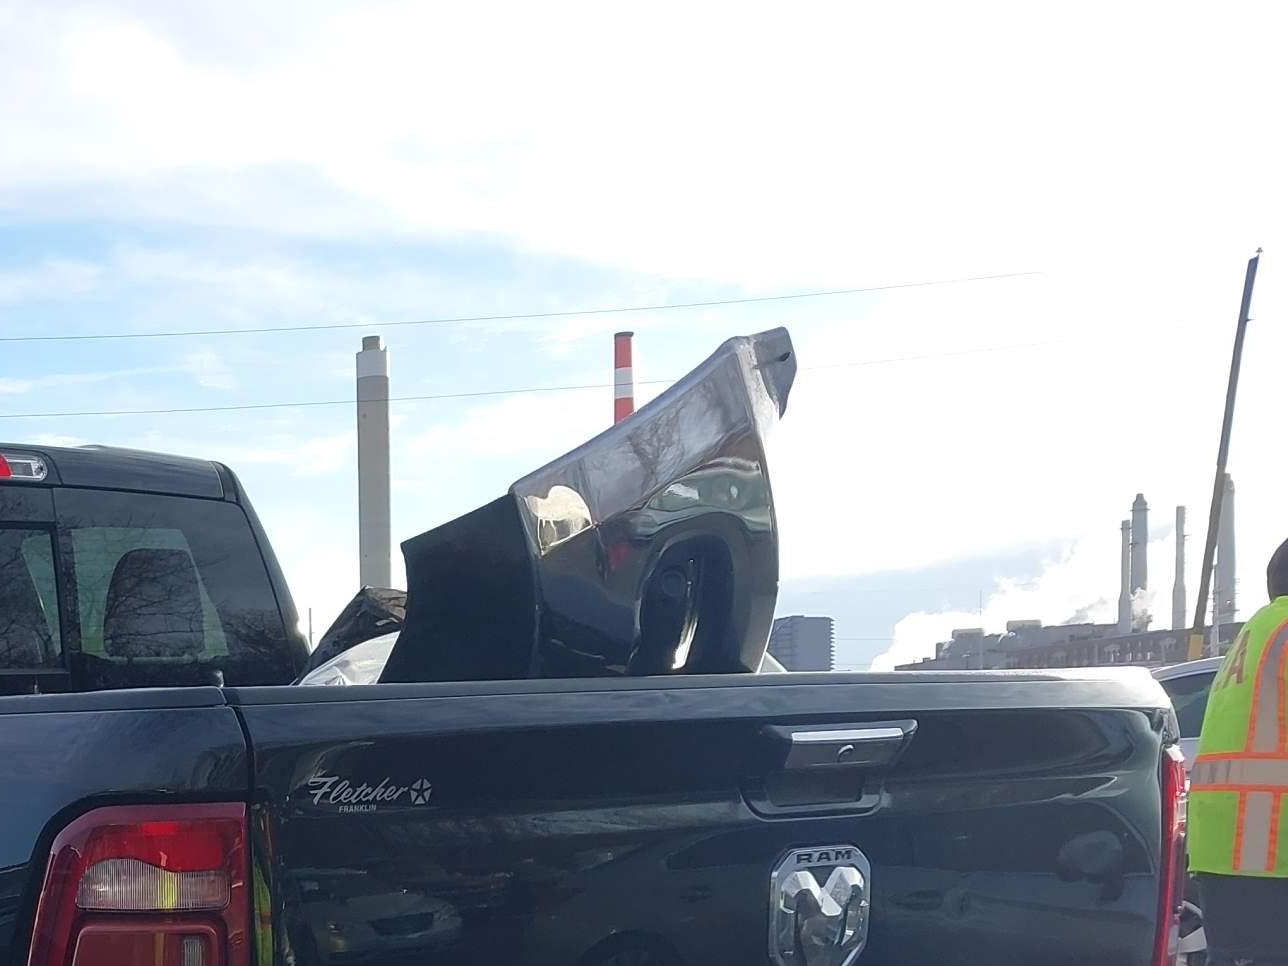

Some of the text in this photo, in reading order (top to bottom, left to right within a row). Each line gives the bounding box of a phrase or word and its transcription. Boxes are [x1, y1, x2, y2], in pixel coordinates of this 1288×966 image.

[307, 775, 409, 805] Fletcher
[338, 803, 377, 814] FRANKLIN
[795, 849, 854, 866] RAM
